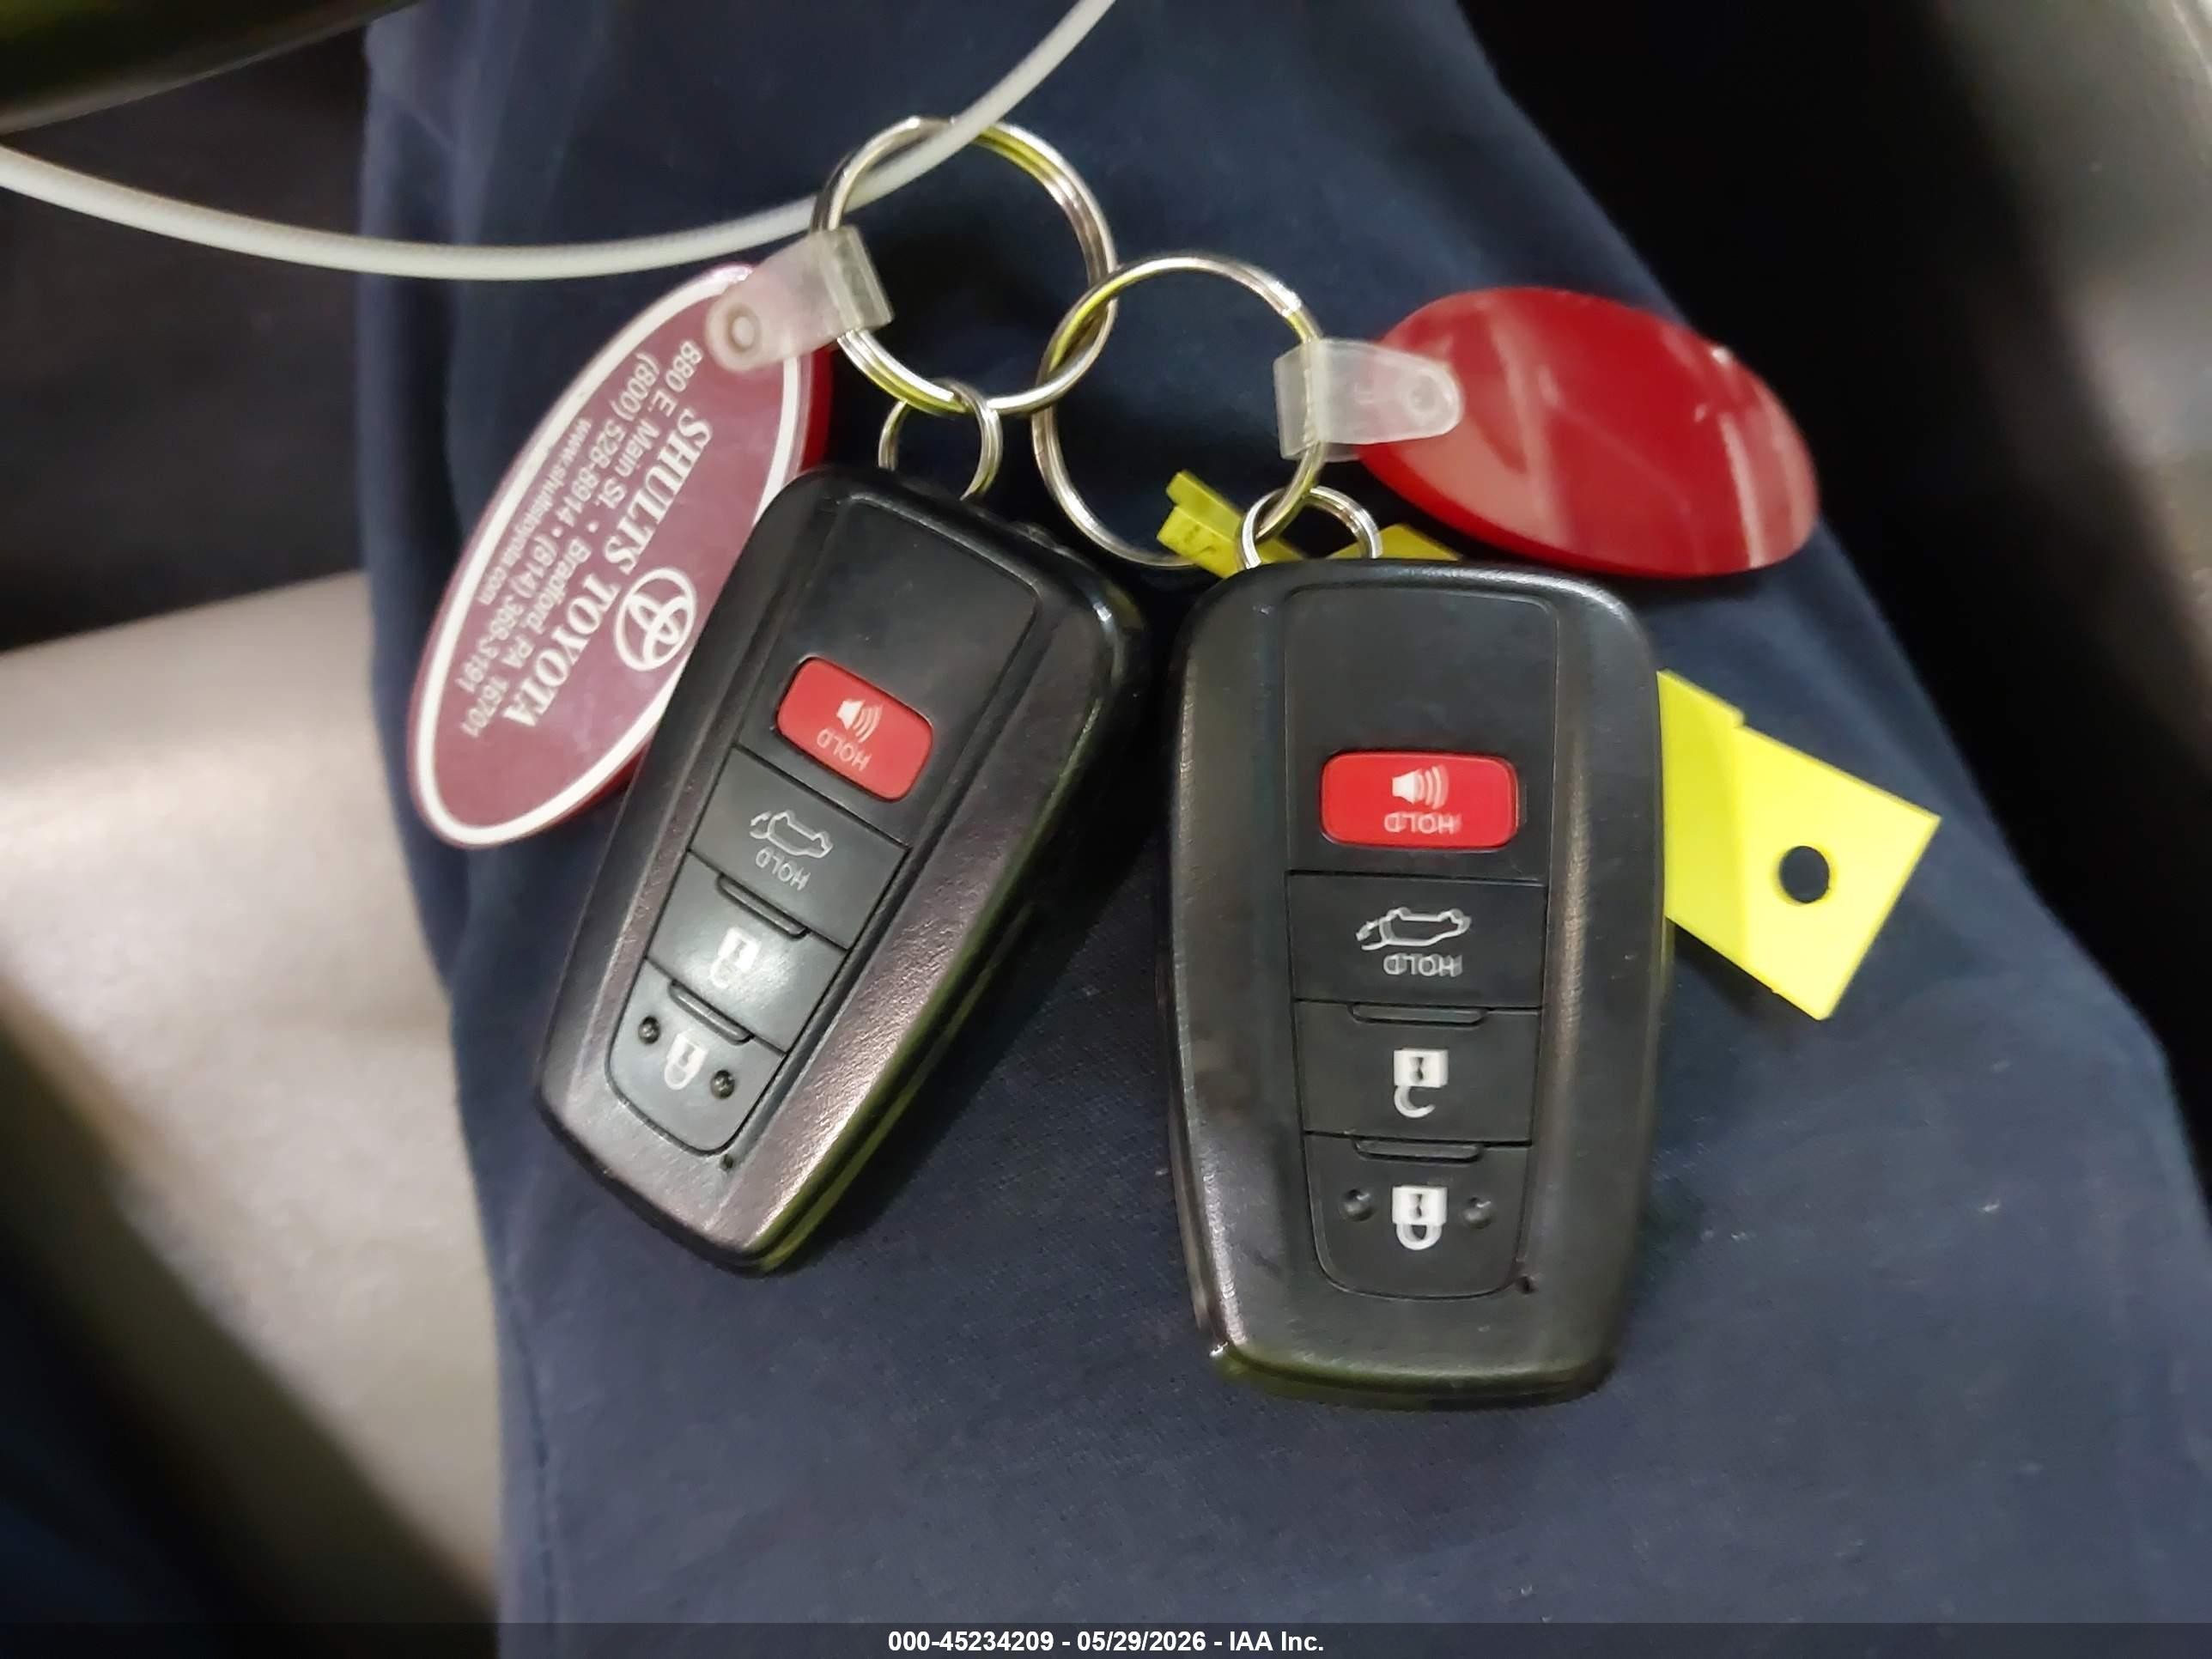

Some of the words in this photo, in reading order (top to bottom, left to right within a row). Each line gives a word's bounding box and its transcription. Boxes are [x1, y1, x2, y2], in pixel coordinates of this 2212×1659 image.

[610, 352, 660, 421] (800)
[665, 340, 703, 393] 880
[647, 388, 678, 417] E.
[555, 419, 626, 526] 528-8914
[614, 418, 659, 477] Main
[477, 418, 592, 605] www.shultstoyota.com
[592, 476, 628, 510] St.
[604, 408, 711, 574] SHULTS
[509, 534, 557, 599] (814)
[500, 634, 534, 668] PA
[502, 574, 619, 726] TOYOTA
[461, 675, 510, 737] 16701
[817, 727, 873, 771] HOLD
[1383, 811, 1462, 835] HOLD
[755, 847, 811, 891] HOLD
[1383, 952, 1463, 977] HOLD
